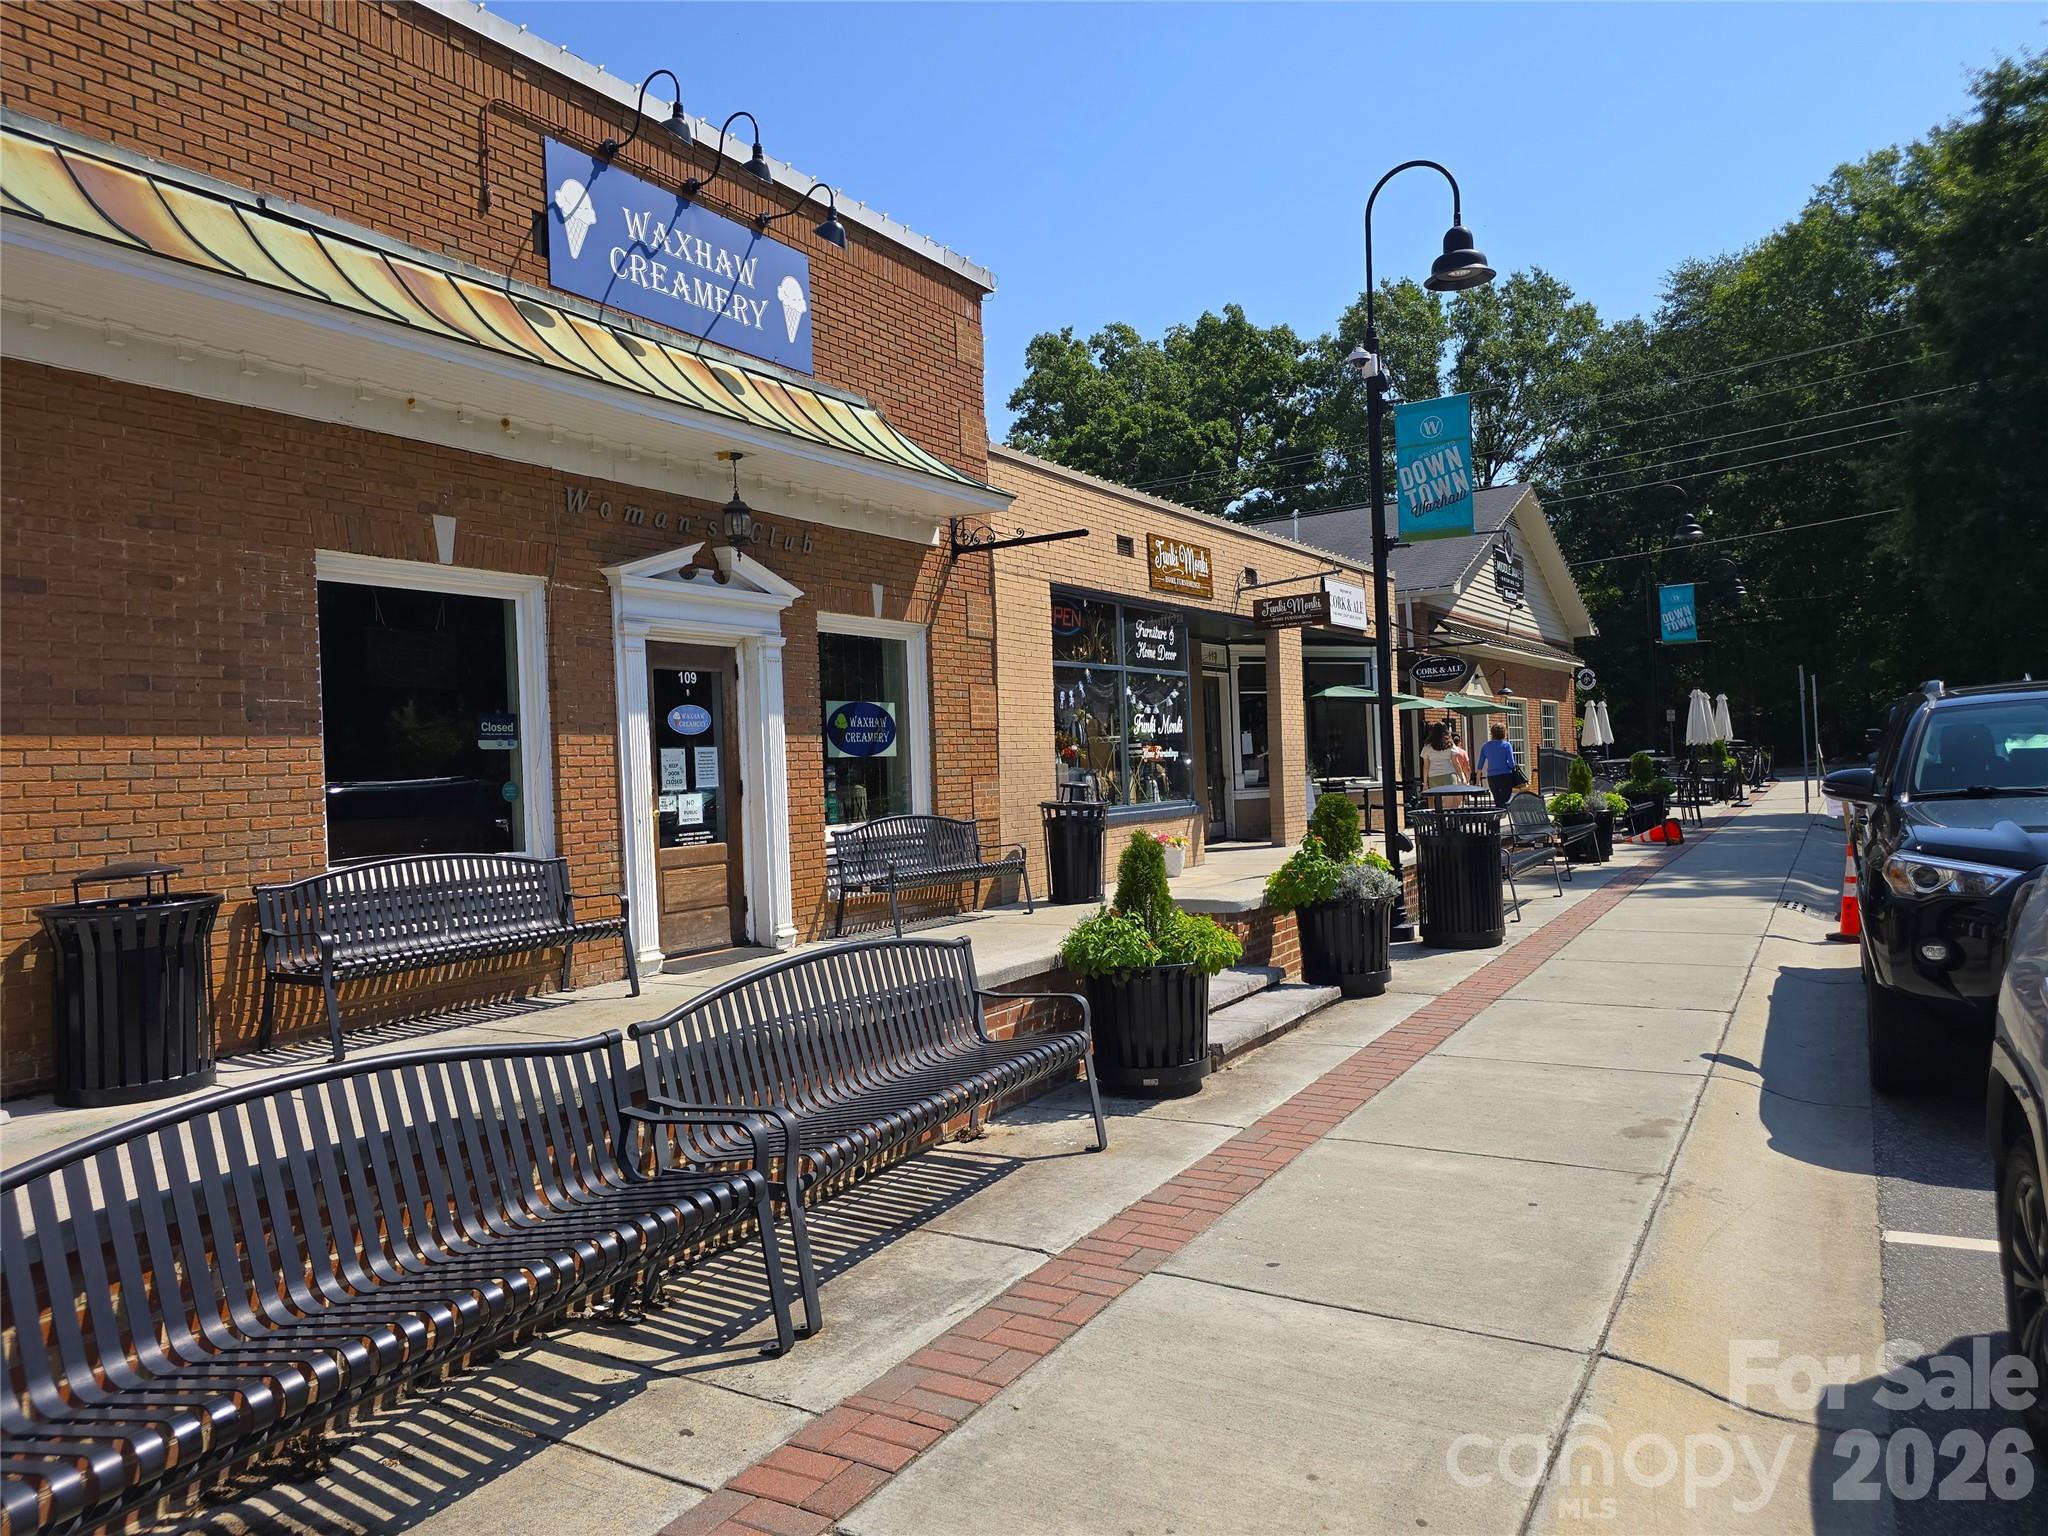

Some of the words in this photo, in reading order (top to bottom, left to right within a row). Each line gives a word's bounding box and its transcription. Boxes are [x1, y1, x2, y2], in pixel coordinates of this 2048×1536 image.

[622, 207, 758, 289] WAXHAW
[609, 246, 769, 331] CREAMERY
[1399, 445, 1463, 490] DOWN
[1404, 469, 1470, 509] TOWN
[1411, 489, 1469, 518] Waxhaw
[565, 486, 718, 537] Woman's
[751, 523, 815, 555] Club
[1155, 539, 1179, 569] Funki
[1179, 544, 1209, 580] Monki
[1053, 606, 1081, 627] PEN
[1262, 600, 1287, 617] Funki
[1287, 595, 1322, 614] Monki
[1353, 600, 1364, 614] ALE
[1662, 605, 1692, 624] DOWN
[1135, 619, 1167, 641] Furniture
[1664, 615, 1695, 632] TOWN
[1136, 641, 1156, 659] Home
[1157, 644, 1177, 661] Decor
[678, 671, 697, 684] 109
[1416, 667, 1438, 676] CORK
[1439, 666, 1446, 674] &
[1447, 664, 1463, 673] ALE
[481, 721, 514, 732] Closed
[849, 715, 887, 728] WAXHAW
[1133, 713, 1156, 738] Funki
[1158, 714, 1183, 735] Monki
[845, 730, 889, 743] CREAMERY
